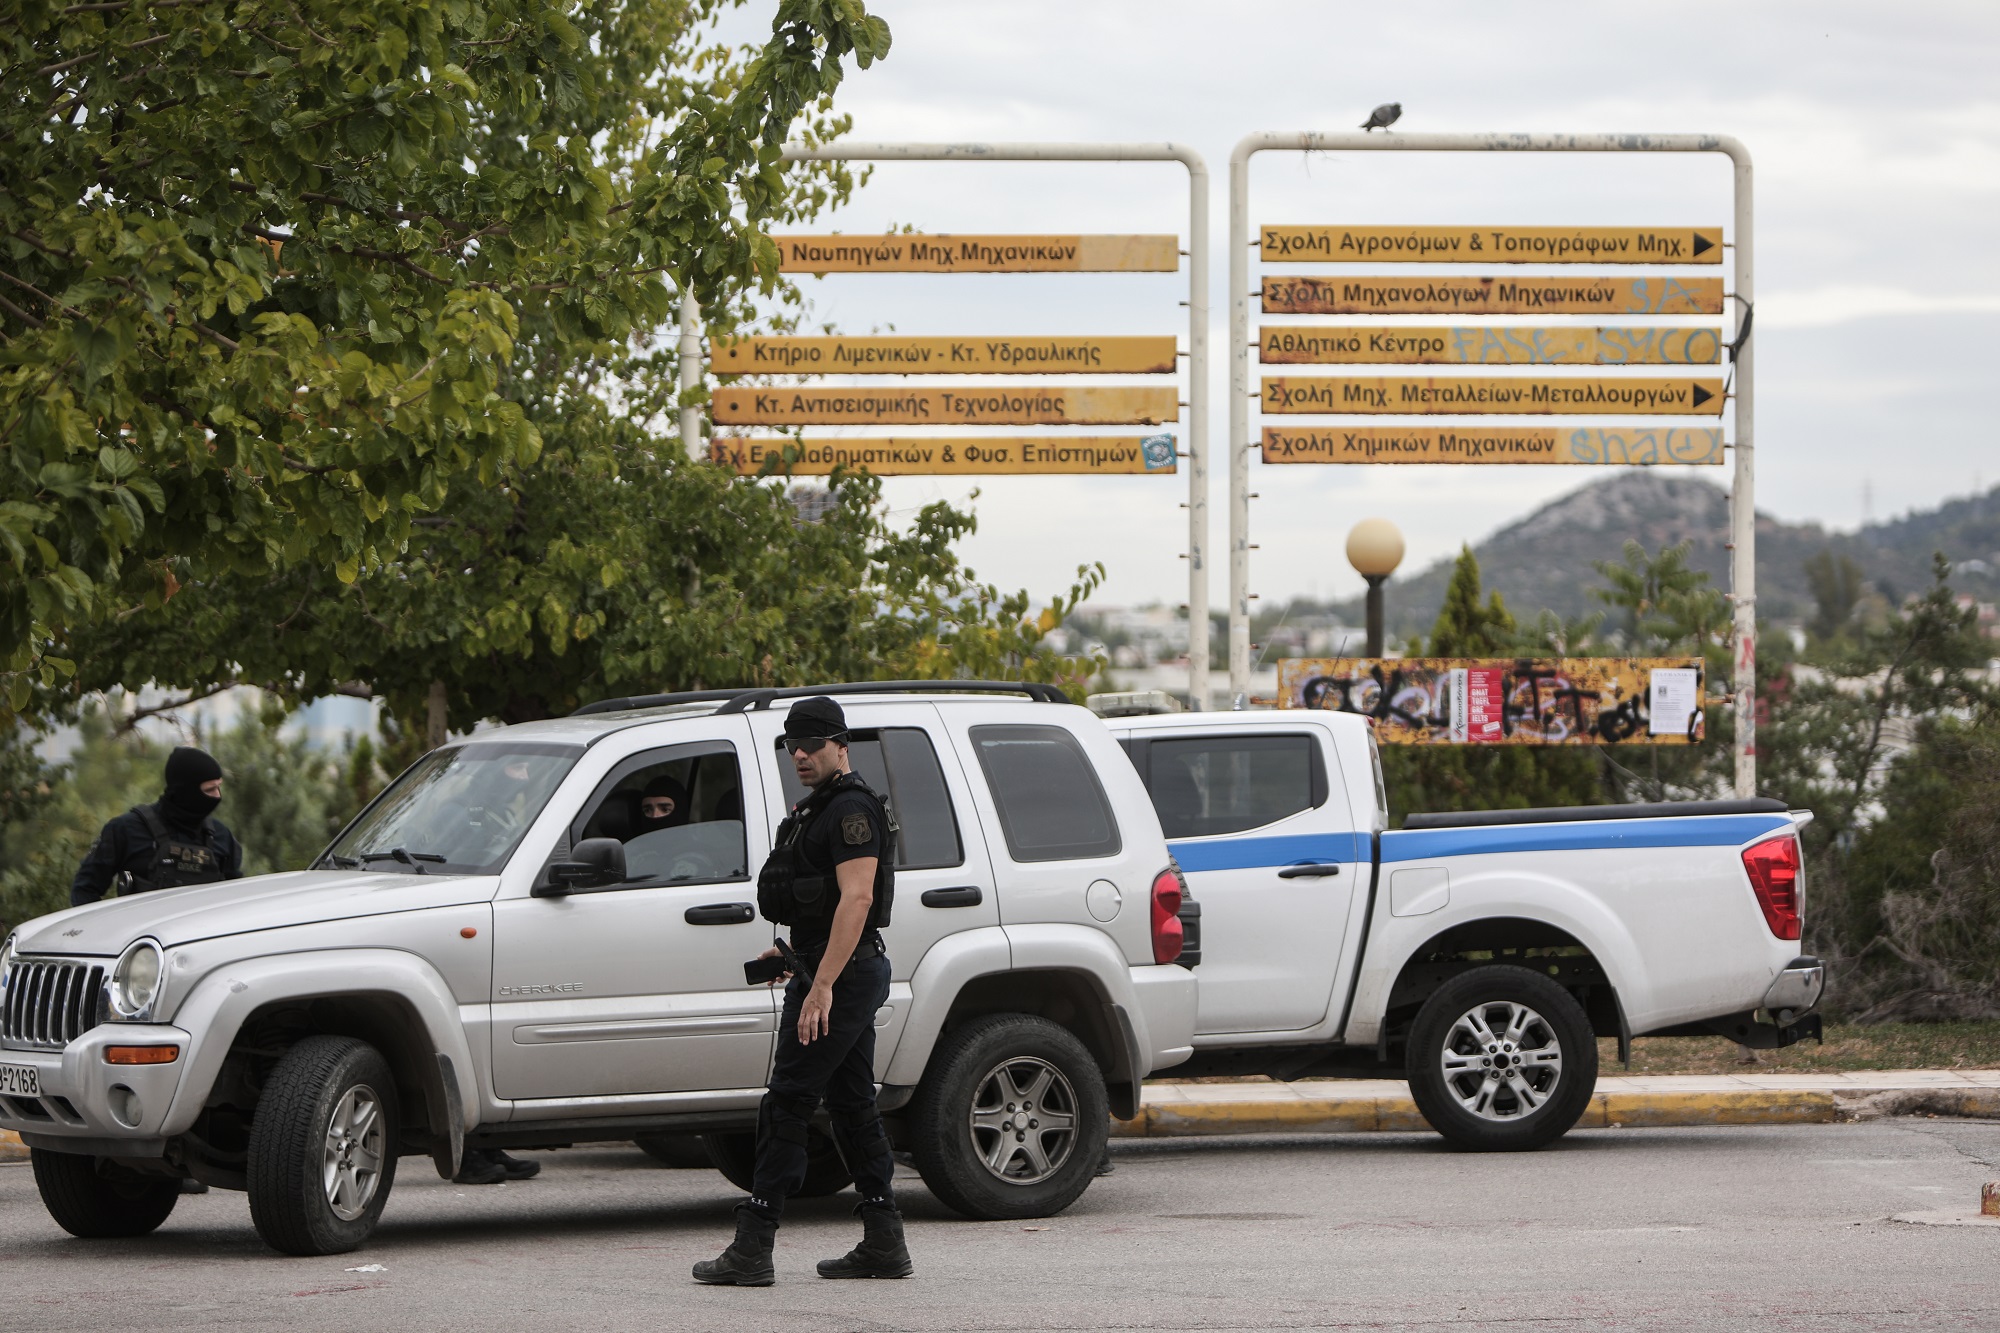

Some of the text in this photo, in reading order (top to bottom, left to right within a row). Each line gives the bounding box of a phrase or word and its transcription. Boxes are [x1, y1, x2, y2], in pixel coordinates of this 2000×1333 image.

[792, 243, 902, 266] Ναυπηγών
[1265, 231, 1687, 257] Σχολή Αγρονόμων & Τοπογράφων Μηχ.
[1269, 283, 1615, 307] Σχολή Μηχανολόγων Μηχανικών
[754, 342, 822, 366] Κτήριο
[833, 343, 931, 366] Λιμενικών
[951, 343, 980, 362] Κτ.
[986, 342, 1101, 366] Υδραυλικής
[1266, 333, 1445, 356] Αθλητικό Κέντρο
[755, 393, 1065, 418] Κτ. Αντισεισμικής Τεχνολογίας
[1268, 383, 1687, 408] Σχολή Μηχ. Μεταλλείων-Μεταλλουργών
[941, 444, 957, 463] &
[964, 445, 1014, 463] Φυσ.
[1022, 444, 1138, 467] Επιστημών
[1268, 433, 1555, 457] Σχολή Χημικών Μηχανικών
[1471, 688, 1489, 696] GMAT
[1471, 697, 1490, 705] TOEFL
[1471, 714, 1489, 722] IELTS
[499, 982, 584, 996] CHEROKEE
